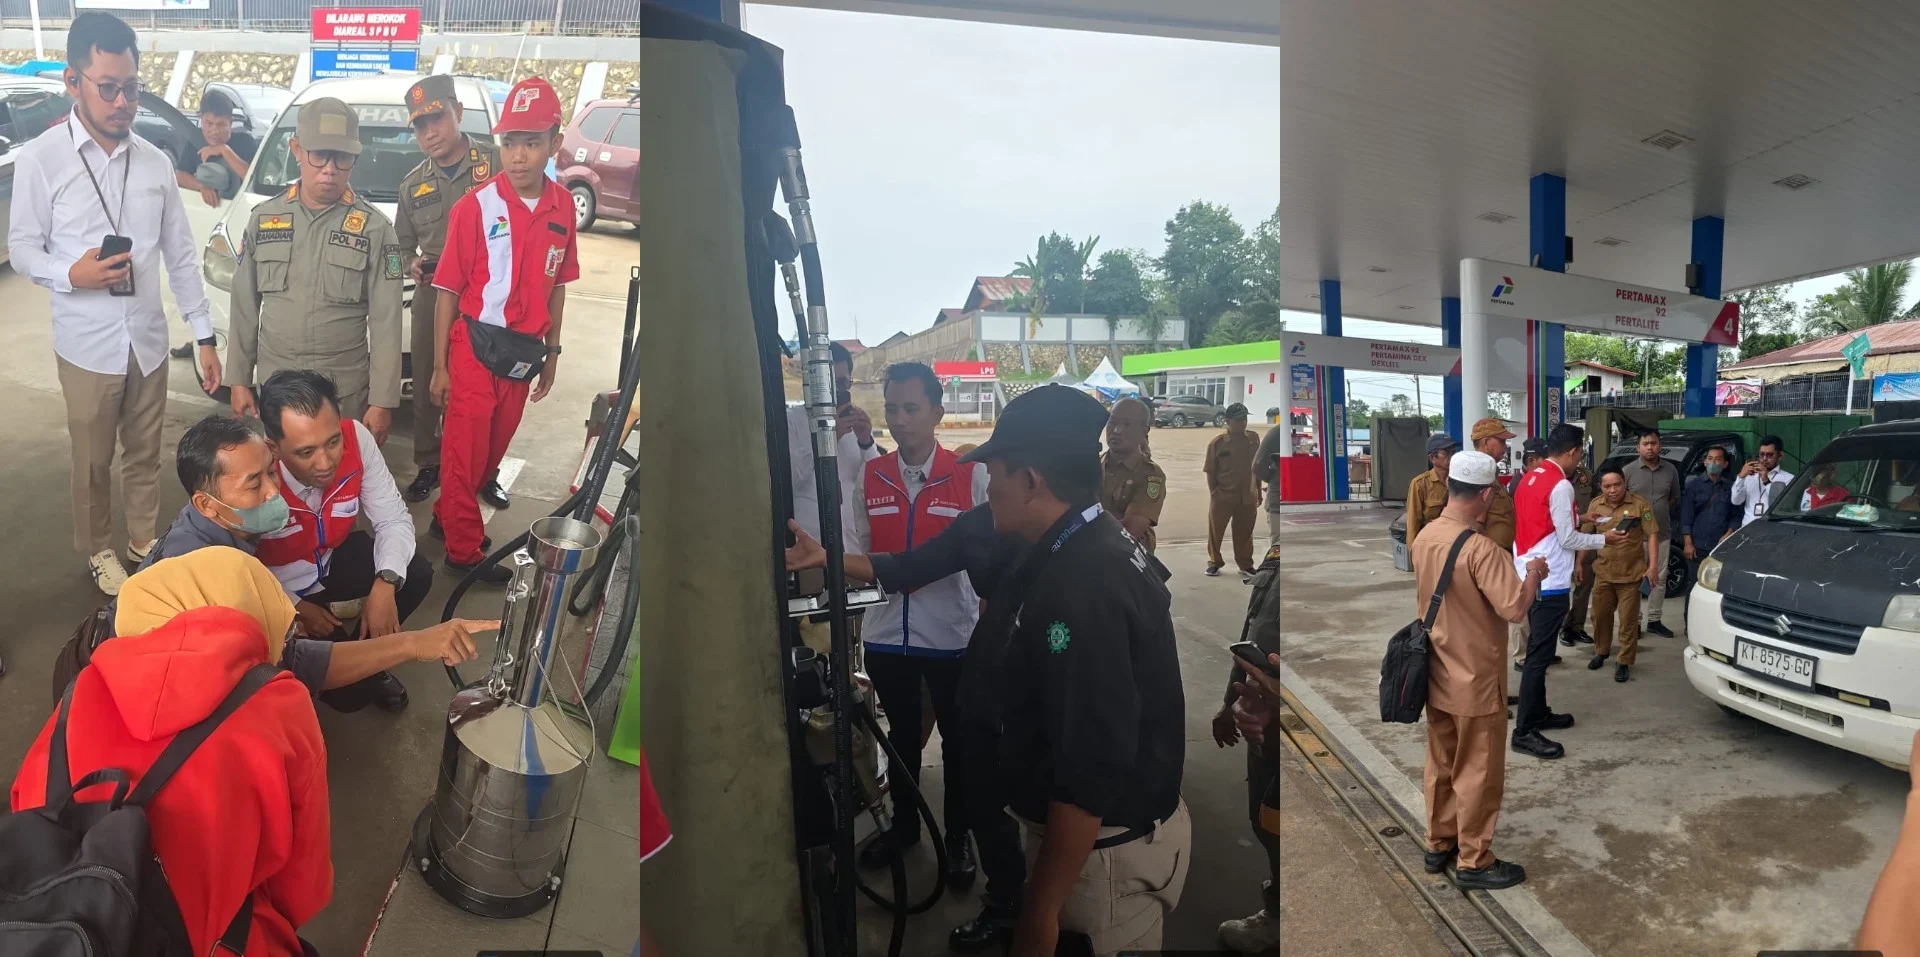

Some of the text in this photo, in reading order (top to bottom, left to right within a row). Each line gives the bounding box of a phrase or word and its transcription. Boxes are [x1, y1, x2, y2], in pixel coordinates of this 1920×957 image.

[326, 13, 406, 24] DILARANG MEROKOK
[333, 26, 367, 36] DIAREAL
[331, 233, 368, 249] POL PP
[1615, 288, 1667, 318] PERTAMAX 92
[1615, 315, 1660, 331] PERTALITE
[1724, 317, 1734, 336] 4
[1370, 342, 1420, 354] PERTAMAX 92
[1371, 351, 1427, 362] PERTAMINA DEX
[1371, 359, 1400, 369] DEXLITE
[980, 367, 995, 375] LPG
